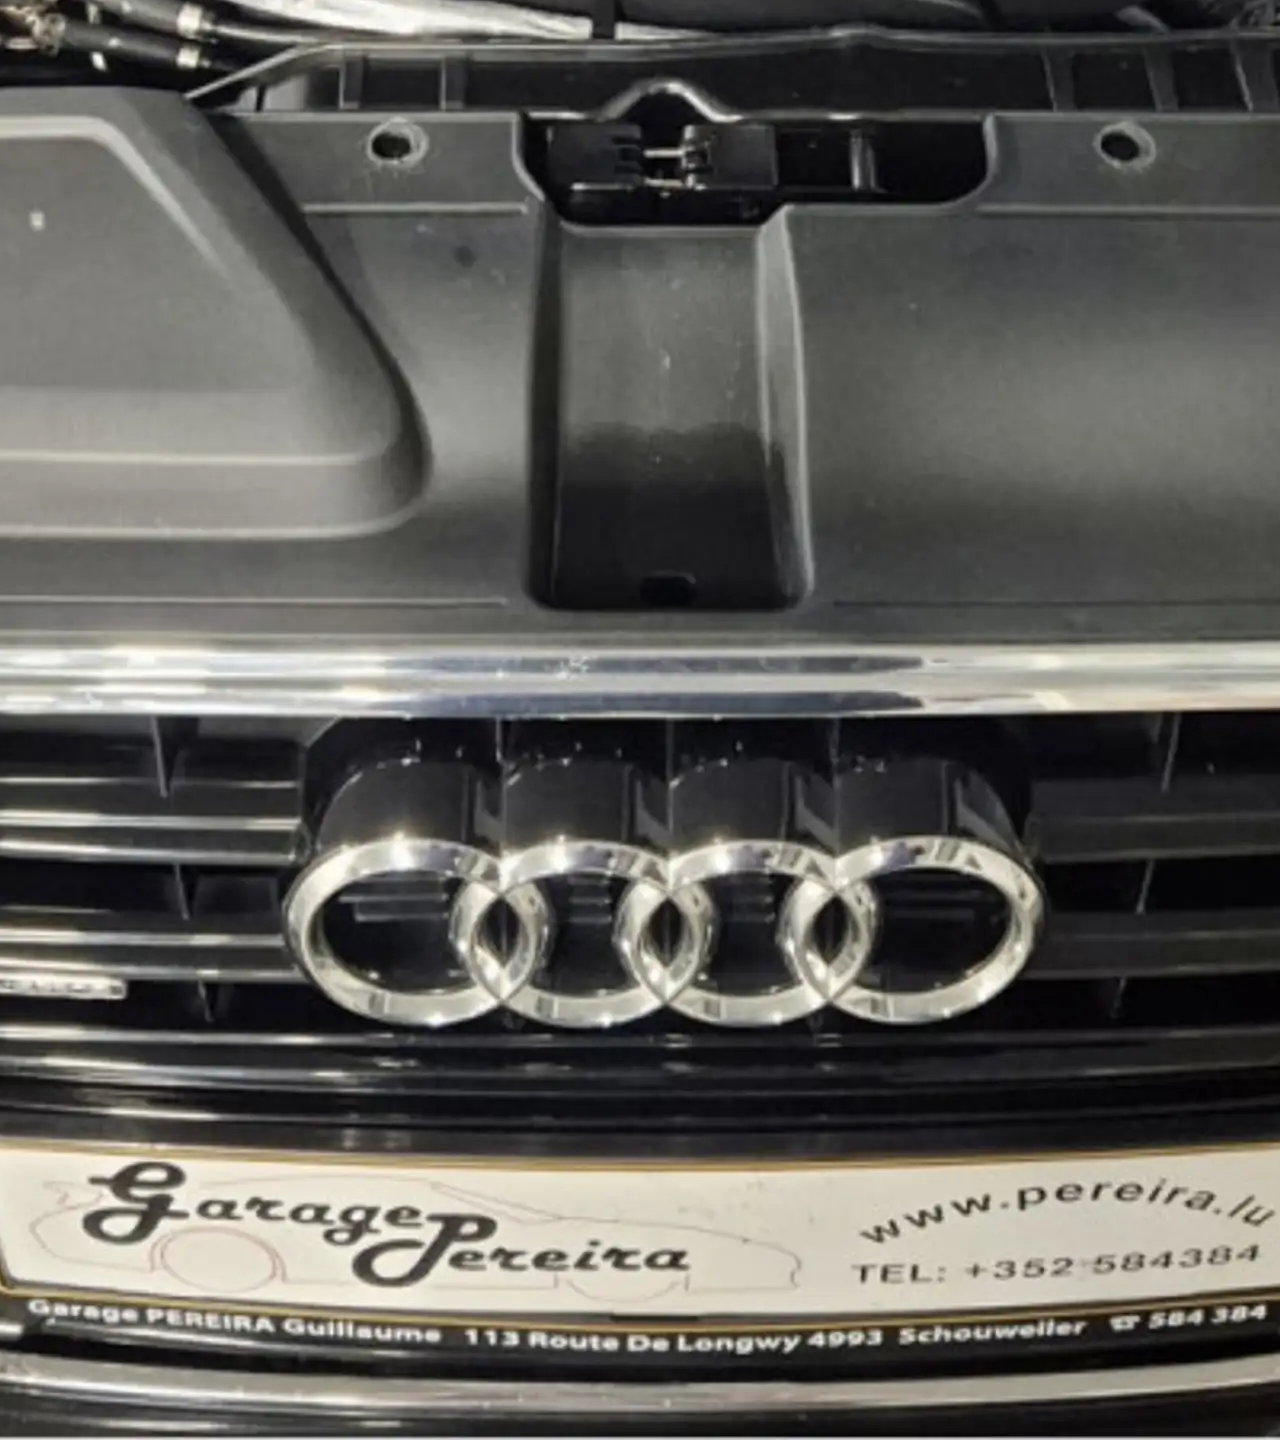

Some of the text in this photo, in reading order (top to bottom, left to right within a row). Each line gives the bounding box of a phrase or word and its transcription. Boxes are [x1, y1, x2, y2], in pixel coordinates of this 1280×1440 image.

[82, 1160, 691, 1288] Garage Pereira
[859, 1177, 1276, 1244] www.pereira.lu
[852, 1243, 1263, 1285] TEL: +352 584384
[28, 1298, 1268, 1355] Garage PEREIRA Guillaume 113 Route De Longwy 4993 Schouweiler 584 384
